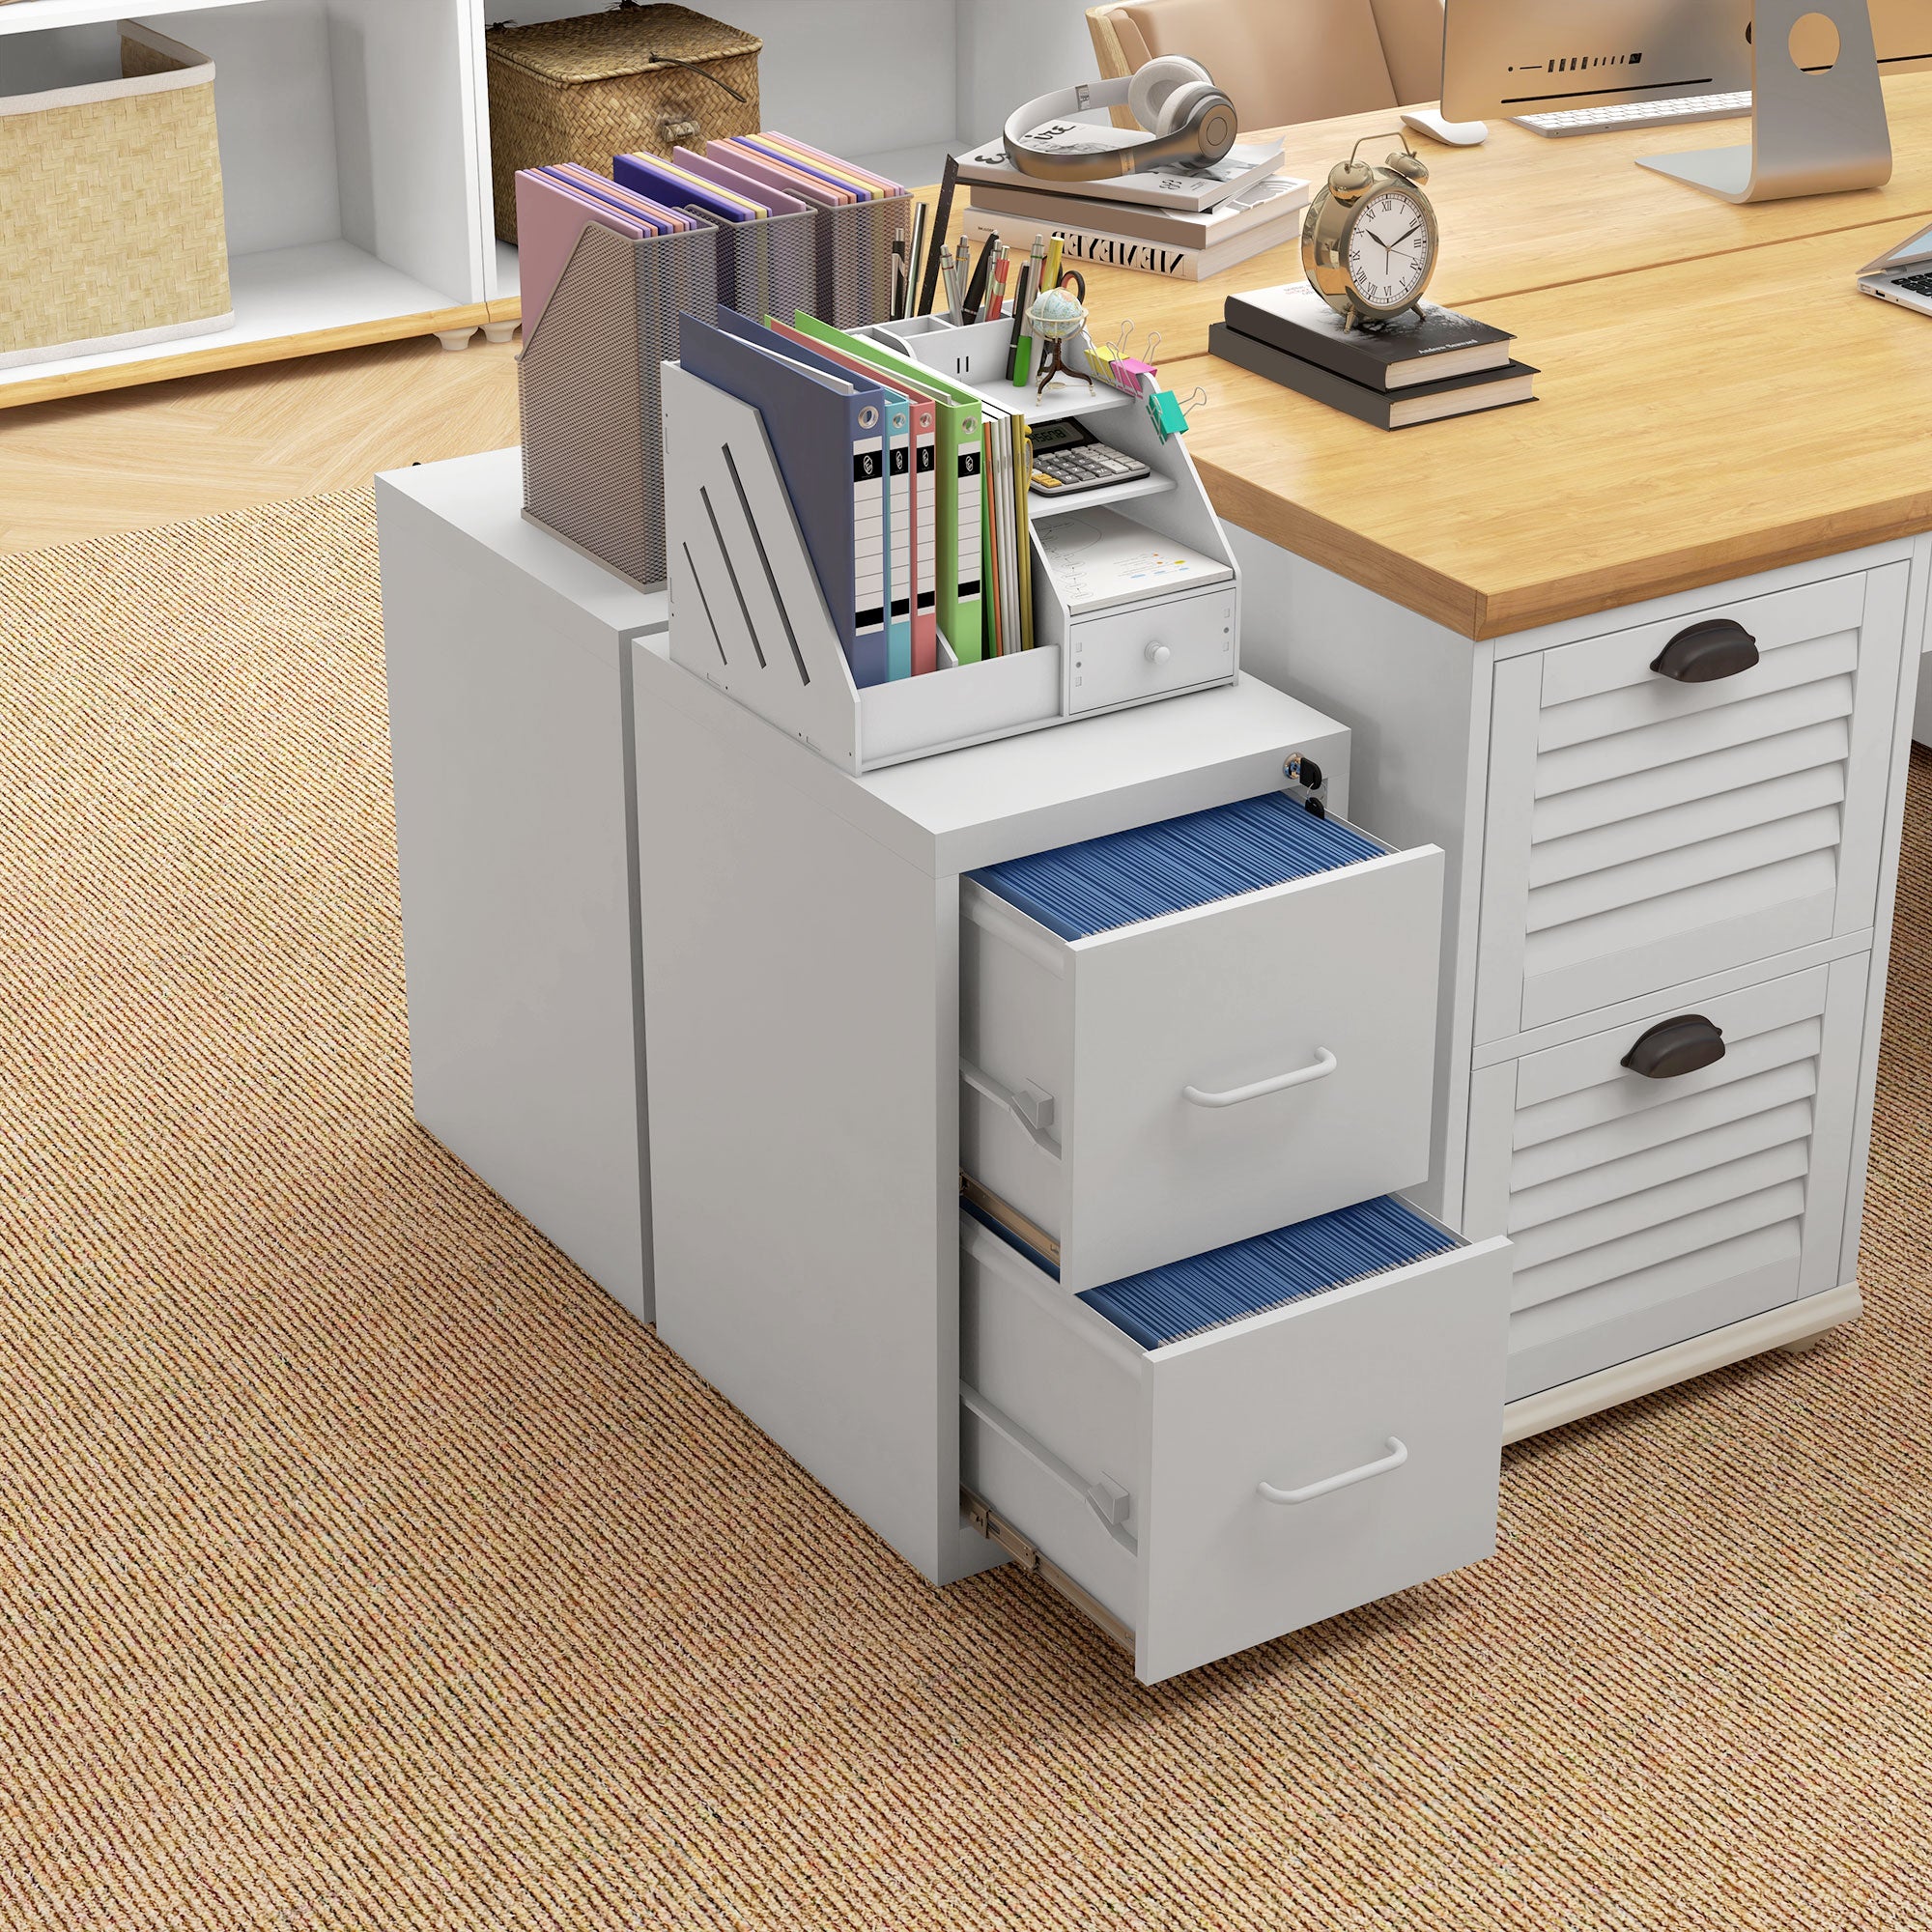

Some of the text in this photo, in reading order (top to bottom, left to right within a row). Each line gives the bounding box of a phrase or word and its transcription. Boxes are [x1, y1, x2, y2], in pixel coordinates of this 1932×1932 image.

[1381, 200, 1392, 213] XII
[1400, 205, 1405, 214] I
[1366, 210, 1376, 222] XI
[1409, 218, 1417, 227] II
[1356, 227, 1365, 238] X
[1352, 249, 1361, 262] IX
[1410, 258, 1418, 270] IV
[1356, 267, 1367, 284] VIII
[1399, 277, 1405, 286] V
[1368, 282, 1378, 295] VII
[1383, 285, 1392, 297] VI
